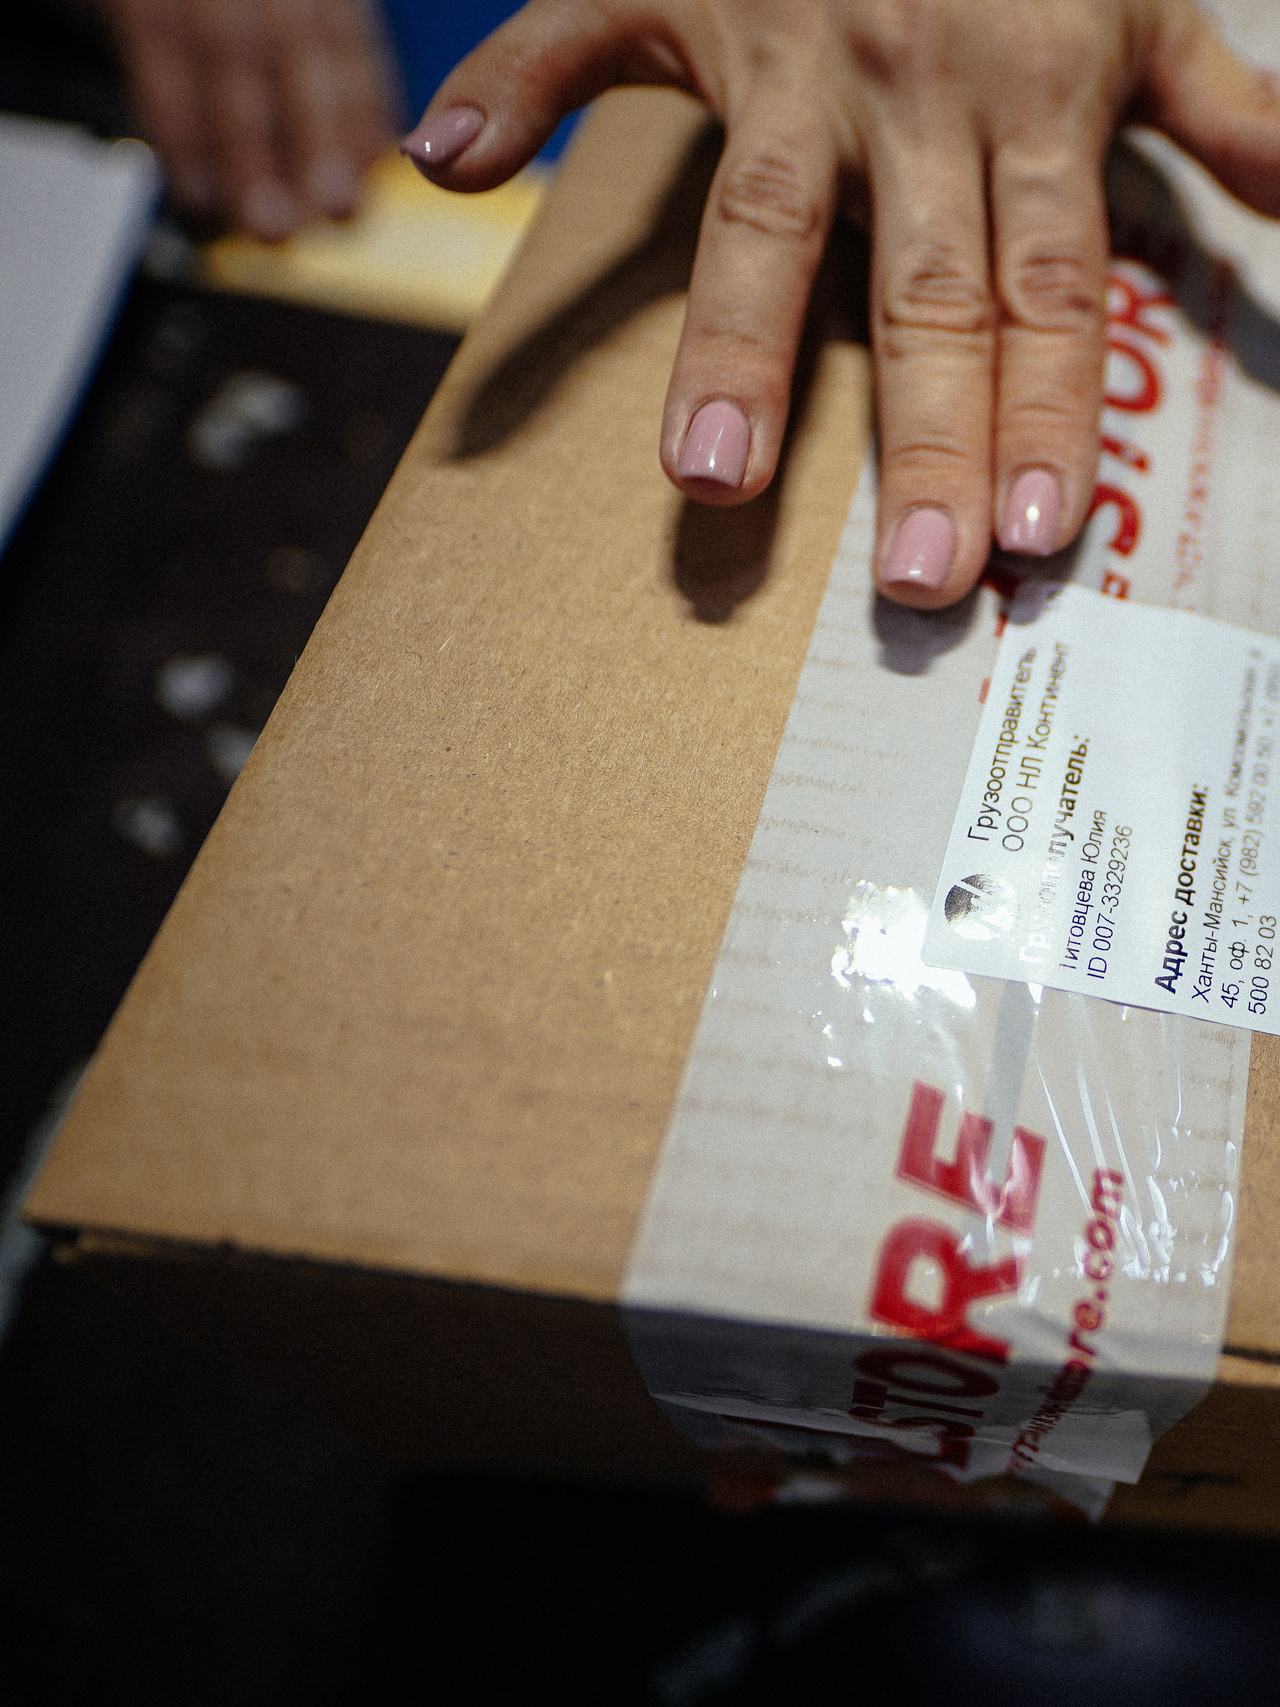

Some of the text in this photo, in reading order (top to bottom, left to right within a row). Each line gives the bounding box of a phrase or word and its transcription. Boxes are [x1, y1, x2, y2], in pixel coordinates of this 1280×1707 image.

[1026, 640, 1070, 750] Континент
[967, 647, 1037, 842] Грузоотправитель
[1016, 756, 1044, 789] НЛ
[1002, 796, 1033, 852] ООО
[1246, 789, 1267, 826] 592
[1019, 734, 1090, 966] Груополучатель:
[1081, 809, 1108, 864] Юлия
[1240, 829, 1264, 877] (982)
[1086, 824, 1133, 980] ID 007-3329236
[1154, 784, 1209, 995] Адрес доставки:
[1235, 881, 1253, 905] +7
[1191, 836, 1236, 1004] Ханты-Мансийск,
[1227, 939, 1250, 971] оф.
[1247, 915, 1277, 1015] 500 82 03
[1220, 980, 1245, 1009] 45,
